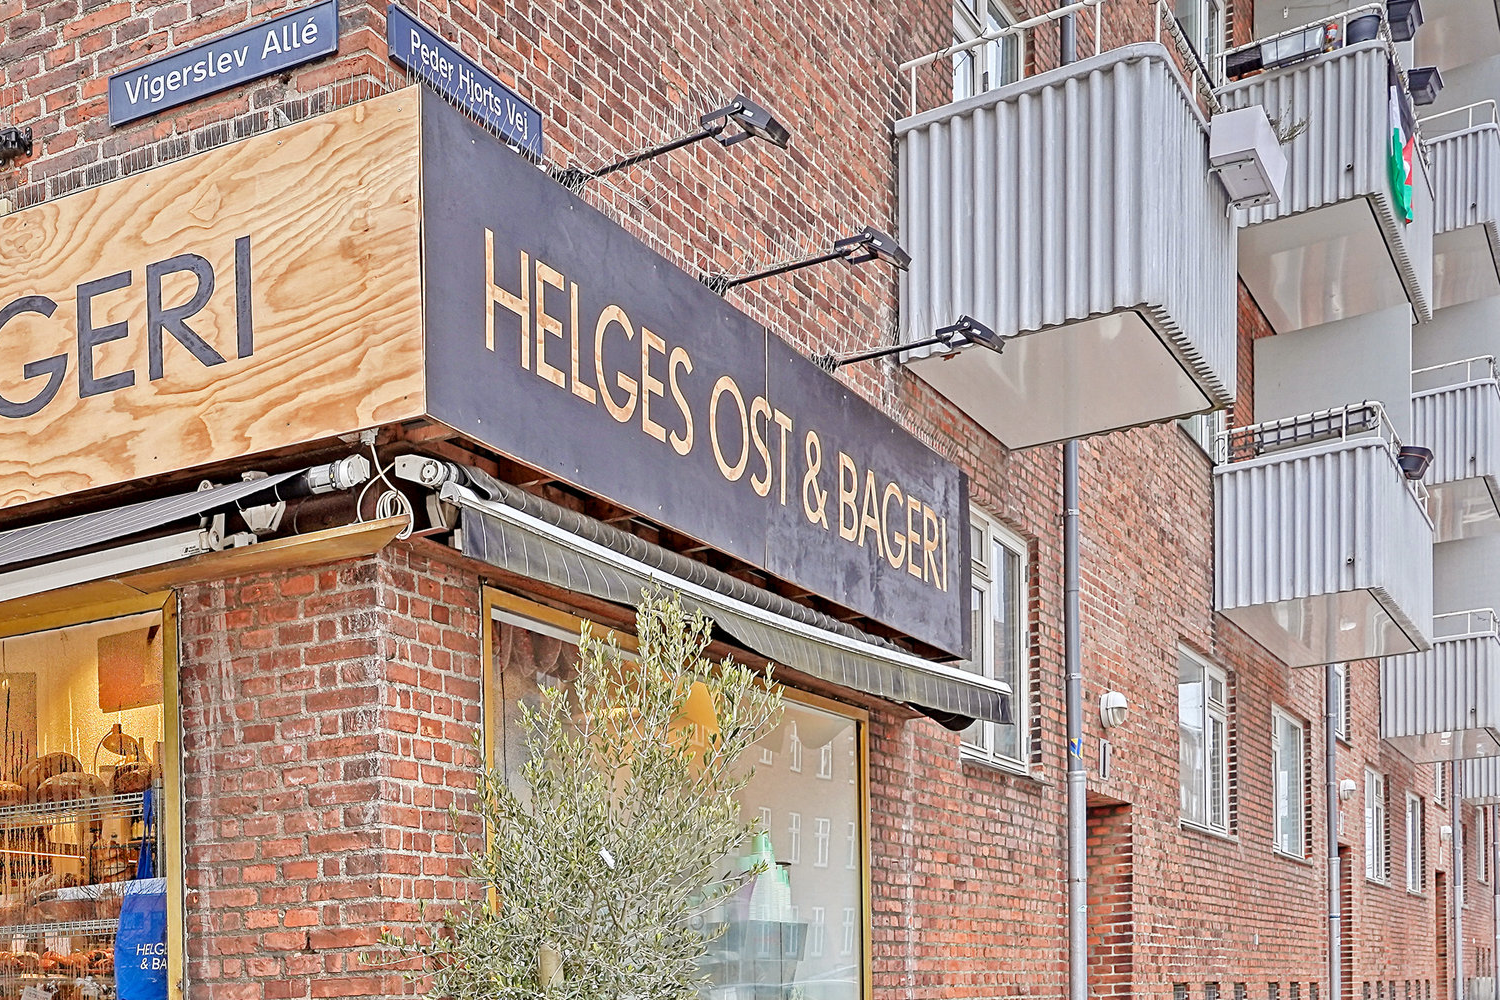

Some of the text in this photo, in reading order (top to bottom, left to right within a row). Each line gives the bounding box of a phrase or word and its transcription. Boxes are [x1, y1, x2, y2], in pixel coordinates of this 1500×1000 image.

[124, 16, 318, 105] Vigerslev Allé
[410, 28, 528, 140] Peder Hjorts Vej
[484, 227, 949, 593] HELGES OST & BAGERI
[140, 957, 149, 970] &
